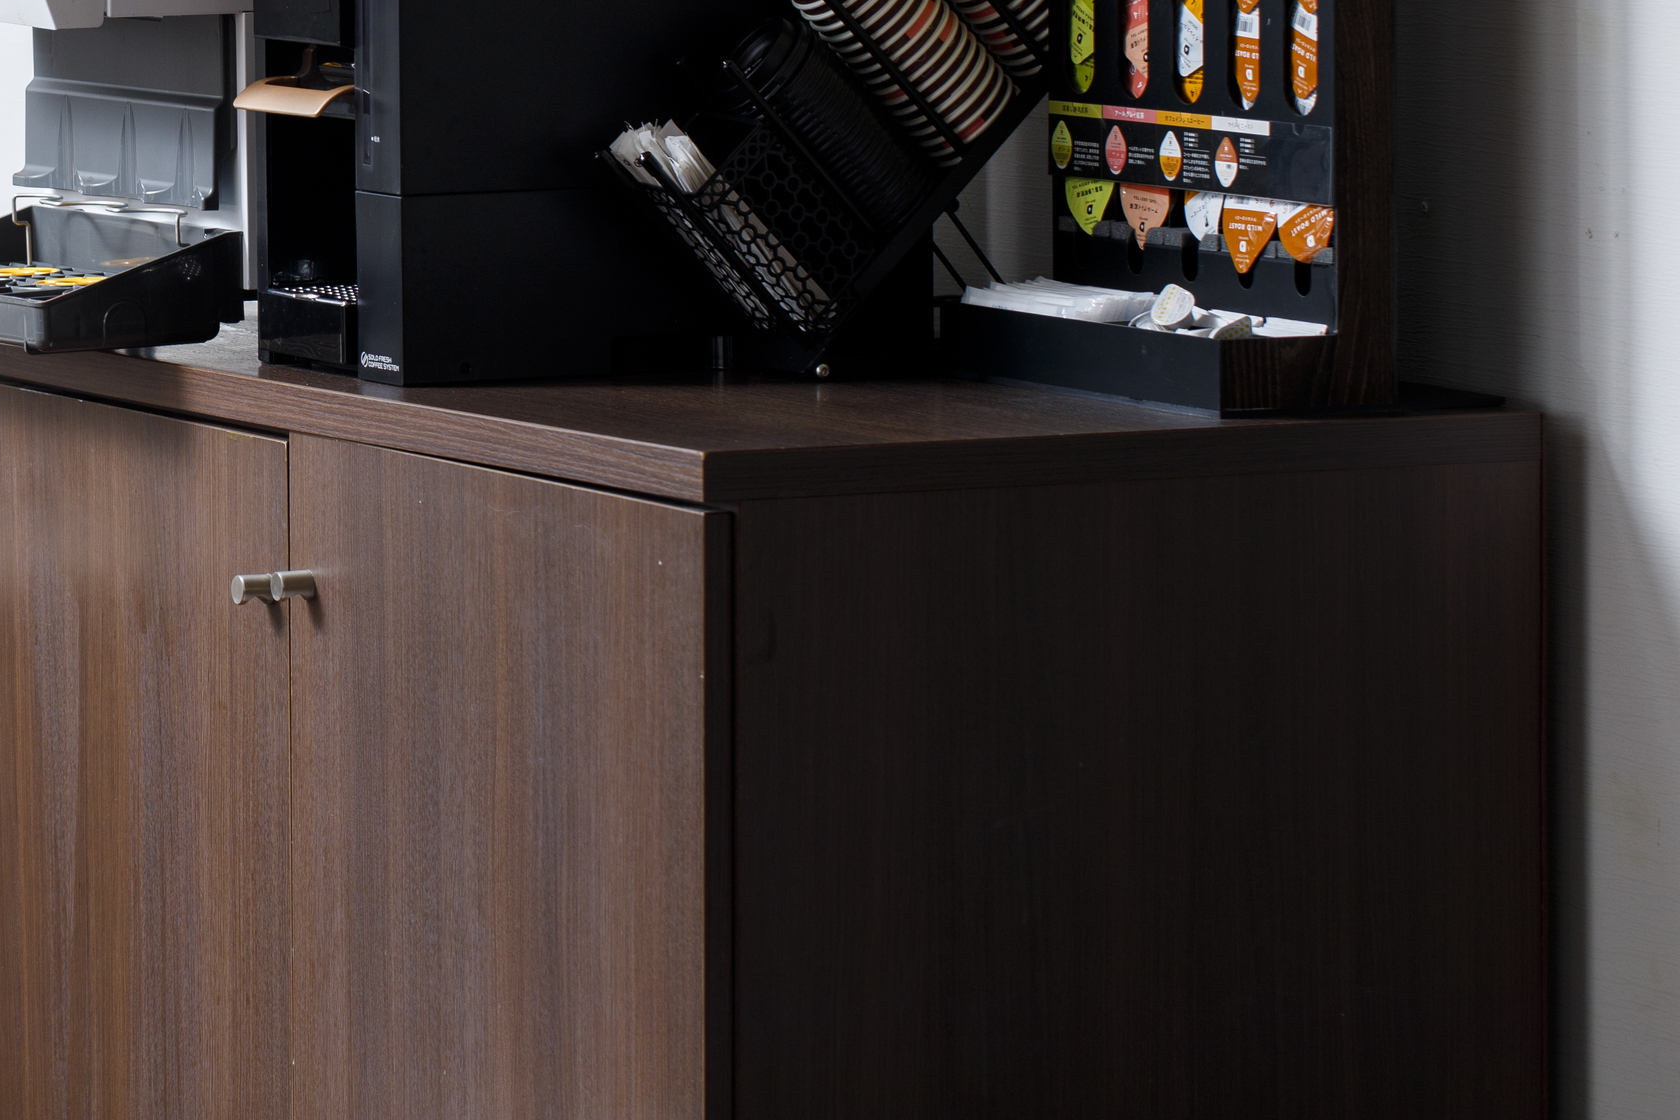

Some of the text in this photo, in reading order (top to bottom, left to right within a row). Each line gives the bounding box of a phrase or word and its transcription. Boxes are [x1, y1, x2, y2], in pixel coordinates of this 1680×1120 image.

[1235, 50, 1250, 58] ROAST
[1291, 43, 1316, 62] ILD ROAST
[1247, 222, 1263, 231] MILD
[1291, 210, 1327, 236] MILD ROAST
[378, 355, 392, 363] FRESH
[368, 361, 400, 372] COFFEE SYSTEM
